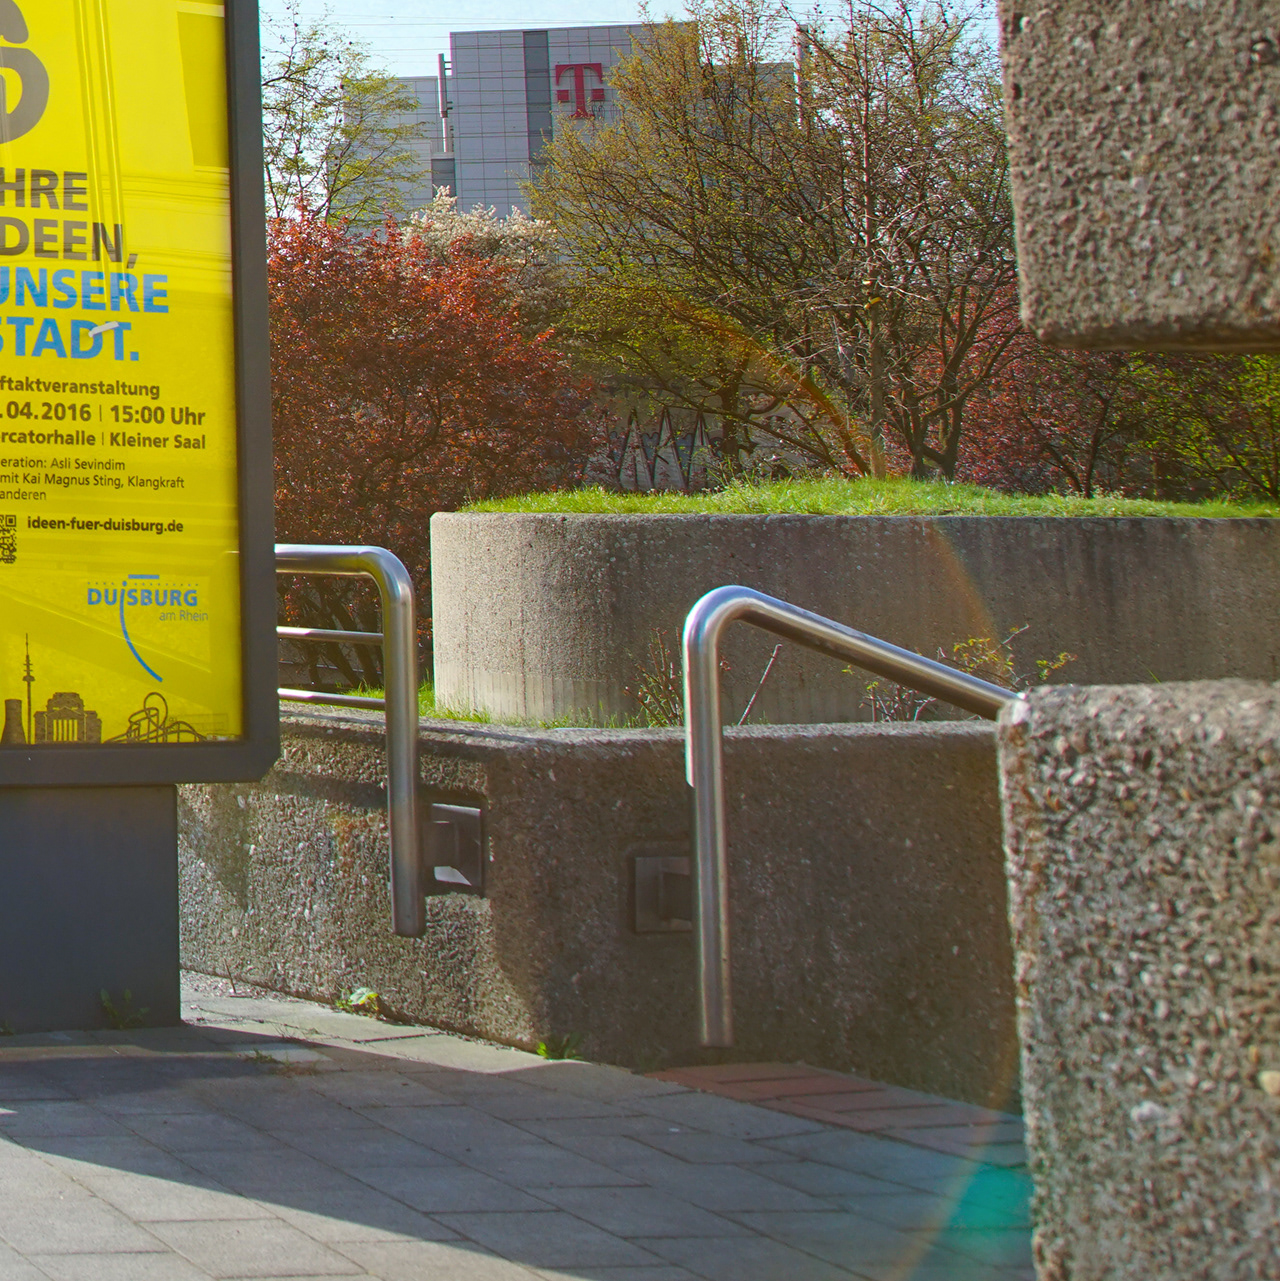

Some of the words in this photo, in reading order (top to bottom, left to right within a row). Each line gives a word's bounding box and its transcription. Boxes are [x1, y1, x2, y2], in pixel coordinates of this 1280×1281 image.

[110, 404, 165, 425] 15:00
[171, 407, 206, 426] Uhr
[110, 431, 169, 449] Kleiner
[174, 434, 206, 450] Saal
[50, 457, 71, 469] Asli
[74, 458, 126, 471] Sevindim
[0, 472, 19, 484] mit
[23, 474, 41, 485] Kai
[44, 474, 90, 488] Magnus
[93, 475, 124, 489] Sting,
[127, 476, 185, 489] Klangkraft
[0, 488, 47, 501] anderen
[27, 516, 184, 535] ideen-fuer-duisburg.de
[159, 611, 176, 621] am
[179, 609, 209, 621] Rhein
